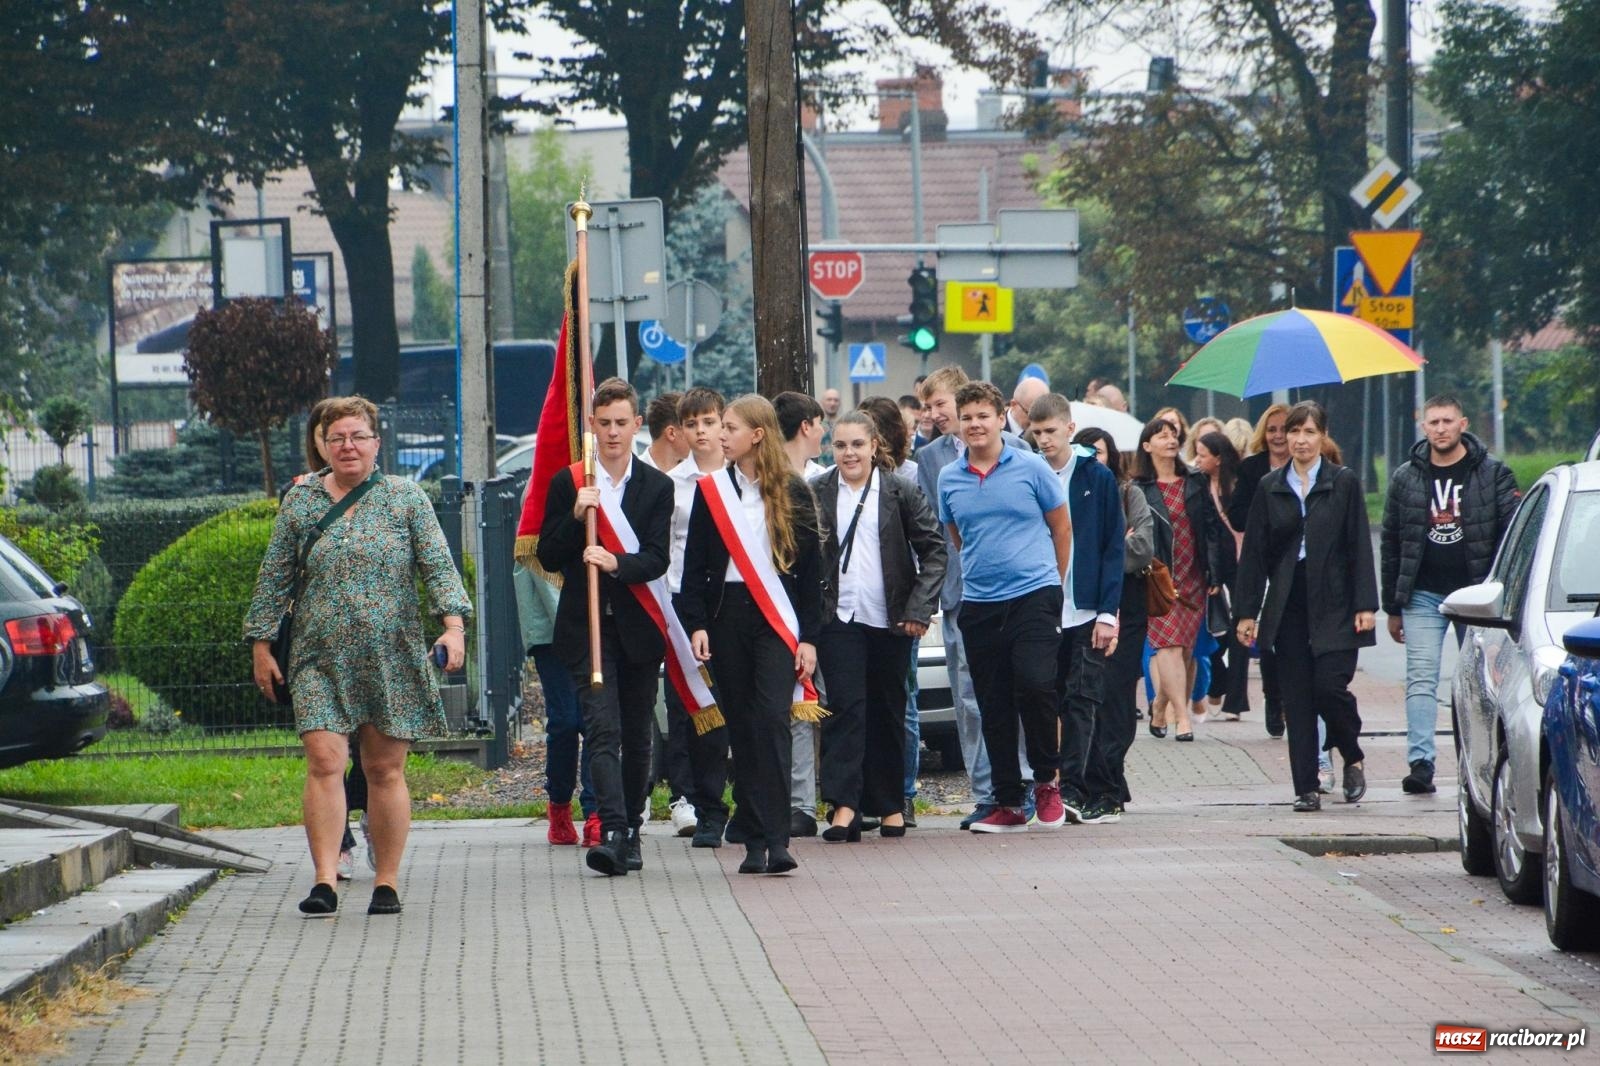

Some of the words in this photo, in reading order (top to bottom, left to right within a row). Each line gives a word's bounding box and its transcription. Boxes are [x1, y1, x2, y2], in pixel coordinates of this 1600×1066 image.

[813, 260, 859, 279] STOP
[1369, 300, 1406, 315] Stop
[1429, 530, 1447, 541] DEAD
